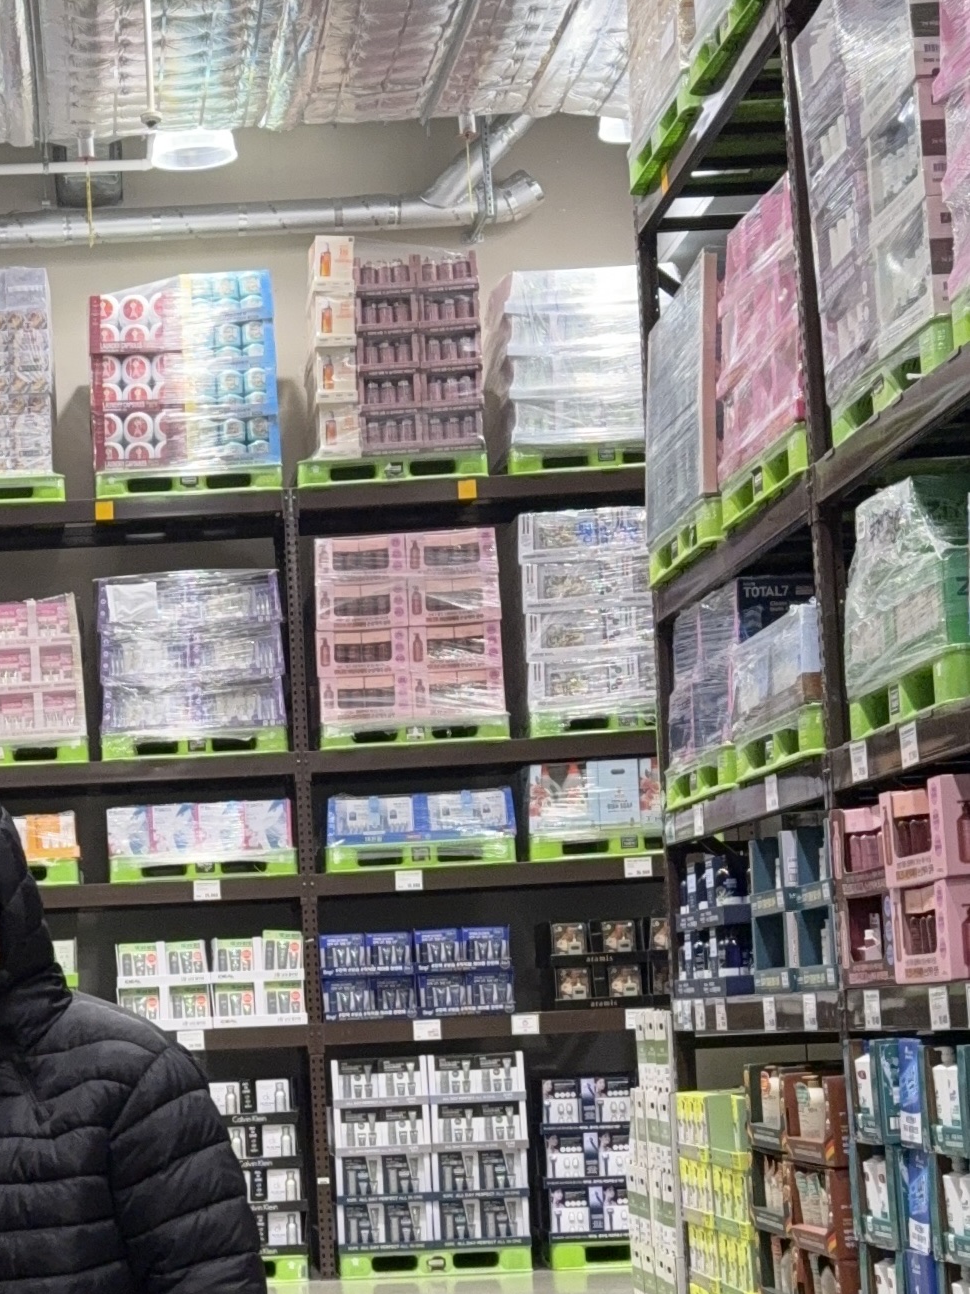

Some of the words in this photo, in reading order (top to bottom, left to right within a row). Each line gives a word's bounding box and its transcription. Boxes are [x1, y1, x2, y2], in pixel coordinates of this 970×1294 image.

[743, 585, 789, 598] TOTAL7
[232, 1115, 252, 1123] Calvin
[257, 1159, 273, 1167] Klein
[263, 1203, 278, 1211] Klein
